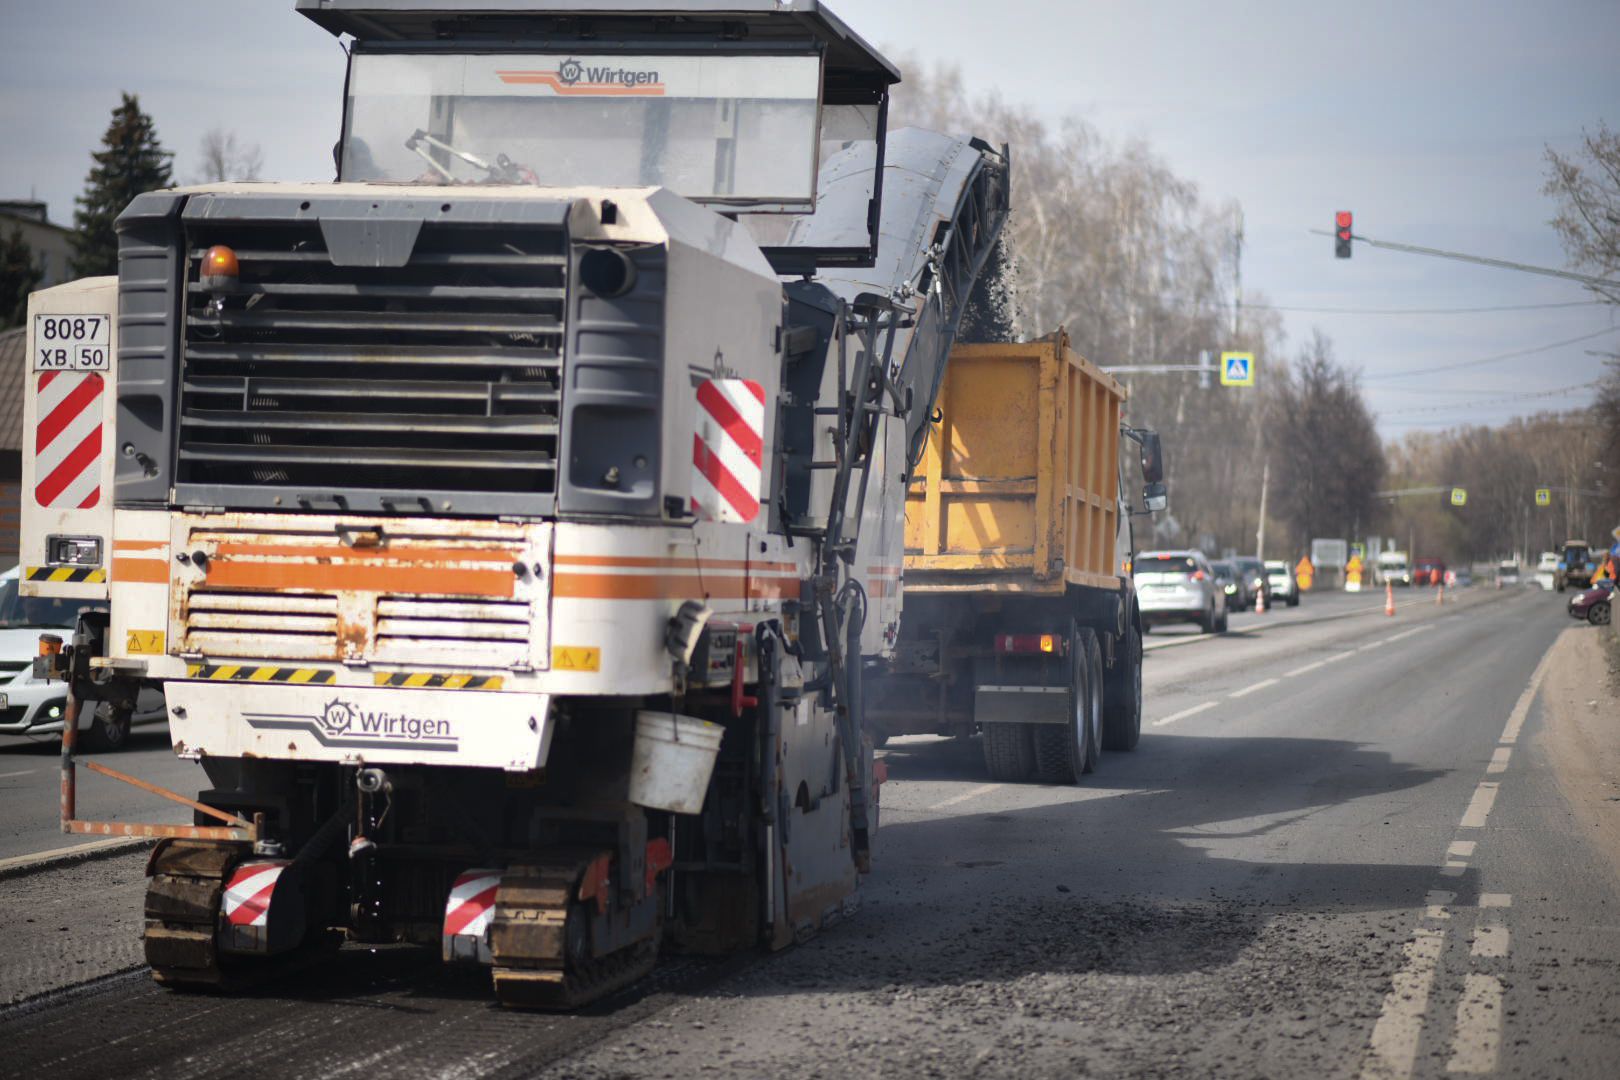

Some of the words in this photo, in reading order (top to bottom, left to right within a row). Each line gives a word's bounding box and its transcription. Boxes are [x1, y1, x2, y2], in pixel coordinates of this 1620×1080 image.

[587, 67, 659, 87] Wirtgen
[44, 318, 101, 340] 8087
[80, 349, 104, 366] 50
[359, 712, 451, 741] Wirtgen
